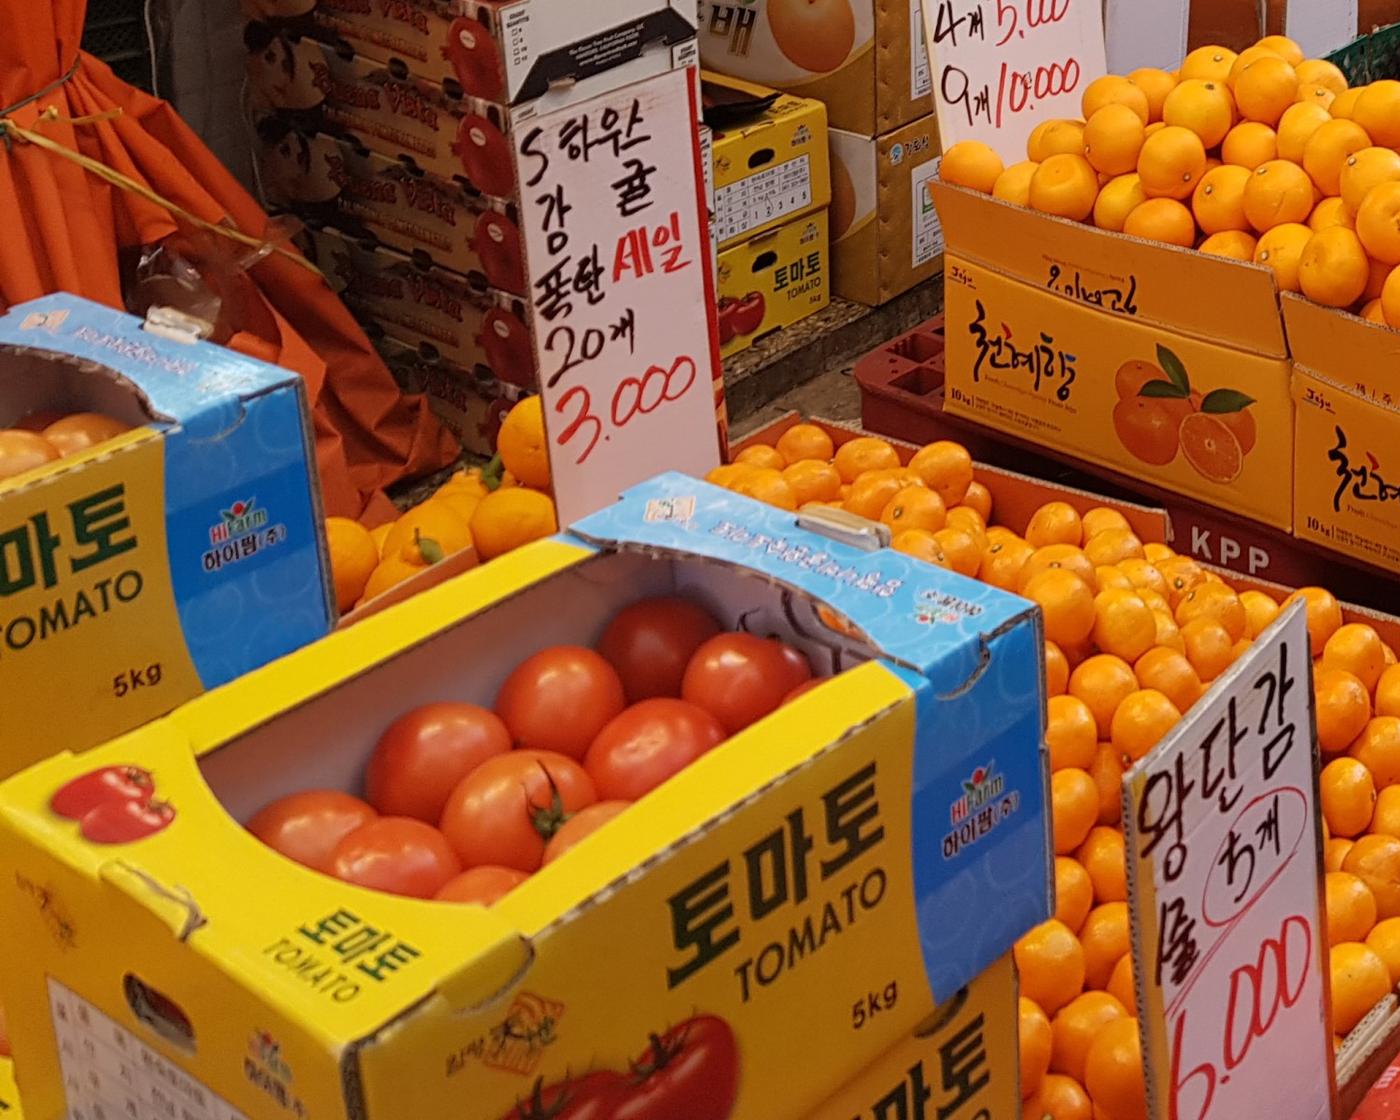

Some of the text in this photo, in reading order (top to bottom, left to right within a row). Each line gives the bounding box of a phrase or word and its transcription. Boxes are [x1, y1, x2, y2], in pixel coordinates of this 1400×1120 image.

[708, 2, 758, 57] 배
[932, 0, 986, 47] 4개
[939, 64, 991, 128] 9개
[520, 98, 652, 188] S 하우스
[536, 183, 572, 257] 감
[611, 157, 657, 218] 귤
[612, 209, 694, 283] 세일
[773, 250, 821, 293] 토마토
[787, 276, 822, 301] TOMATO
[545, 308, 636, 389] 20개
[556, 354, 697, 466] 3.000
[1191, 524, 1271, 574] KPP
[111, 663, 164, 698] 5kg
[1138, 643, 1295, 883] 왕단감
[665, 761, 886, 991] 토마토
[262, 935, 363, 1005] TOMATO
[298, 907, 423, 983] 토마토
[733, 866, 889, 1003] TOMATO
[851, 981, 899, 1030] 5kg
[868, 1011, 991, 1120] 마토
